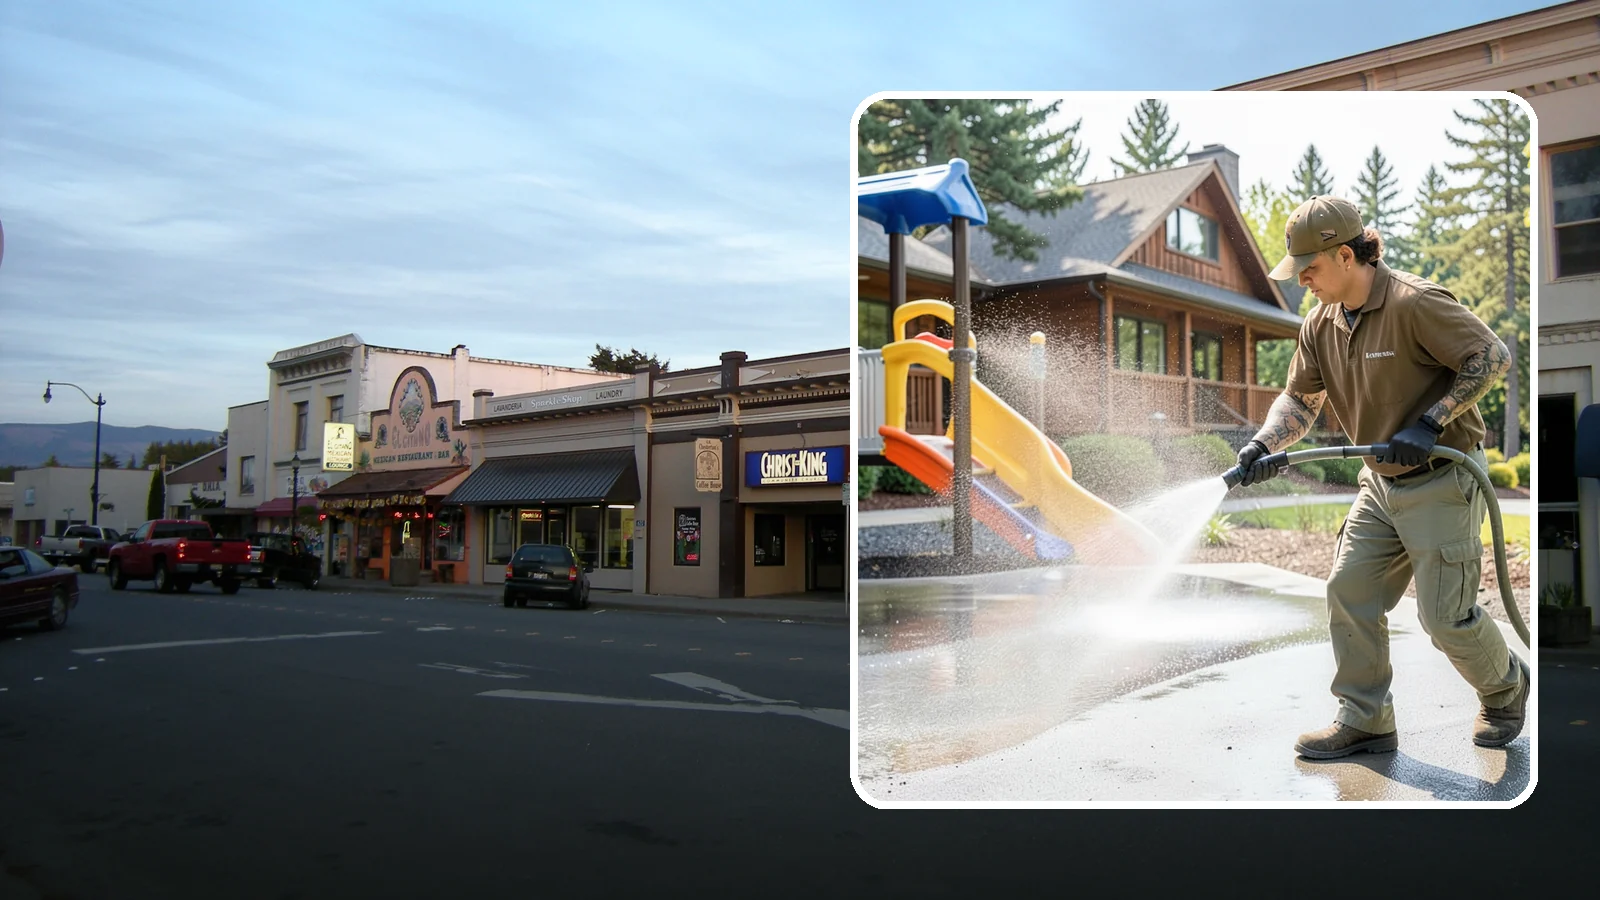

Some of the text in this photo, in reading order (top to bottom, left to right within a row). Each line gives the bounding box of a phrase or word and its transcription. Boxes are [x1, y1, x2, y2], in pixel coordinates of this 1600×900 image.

[595, 389, 623, 400] LAUNDRY
[494, 402, 523, 412] LAVANDERIA
[531, 394, 583, 409] Sparkle Shop
[373, 455, 396, 464] MEXICAN
[397, 451, 433, 463] RESTAURANT
[437, 450, 450, 459] BAR
